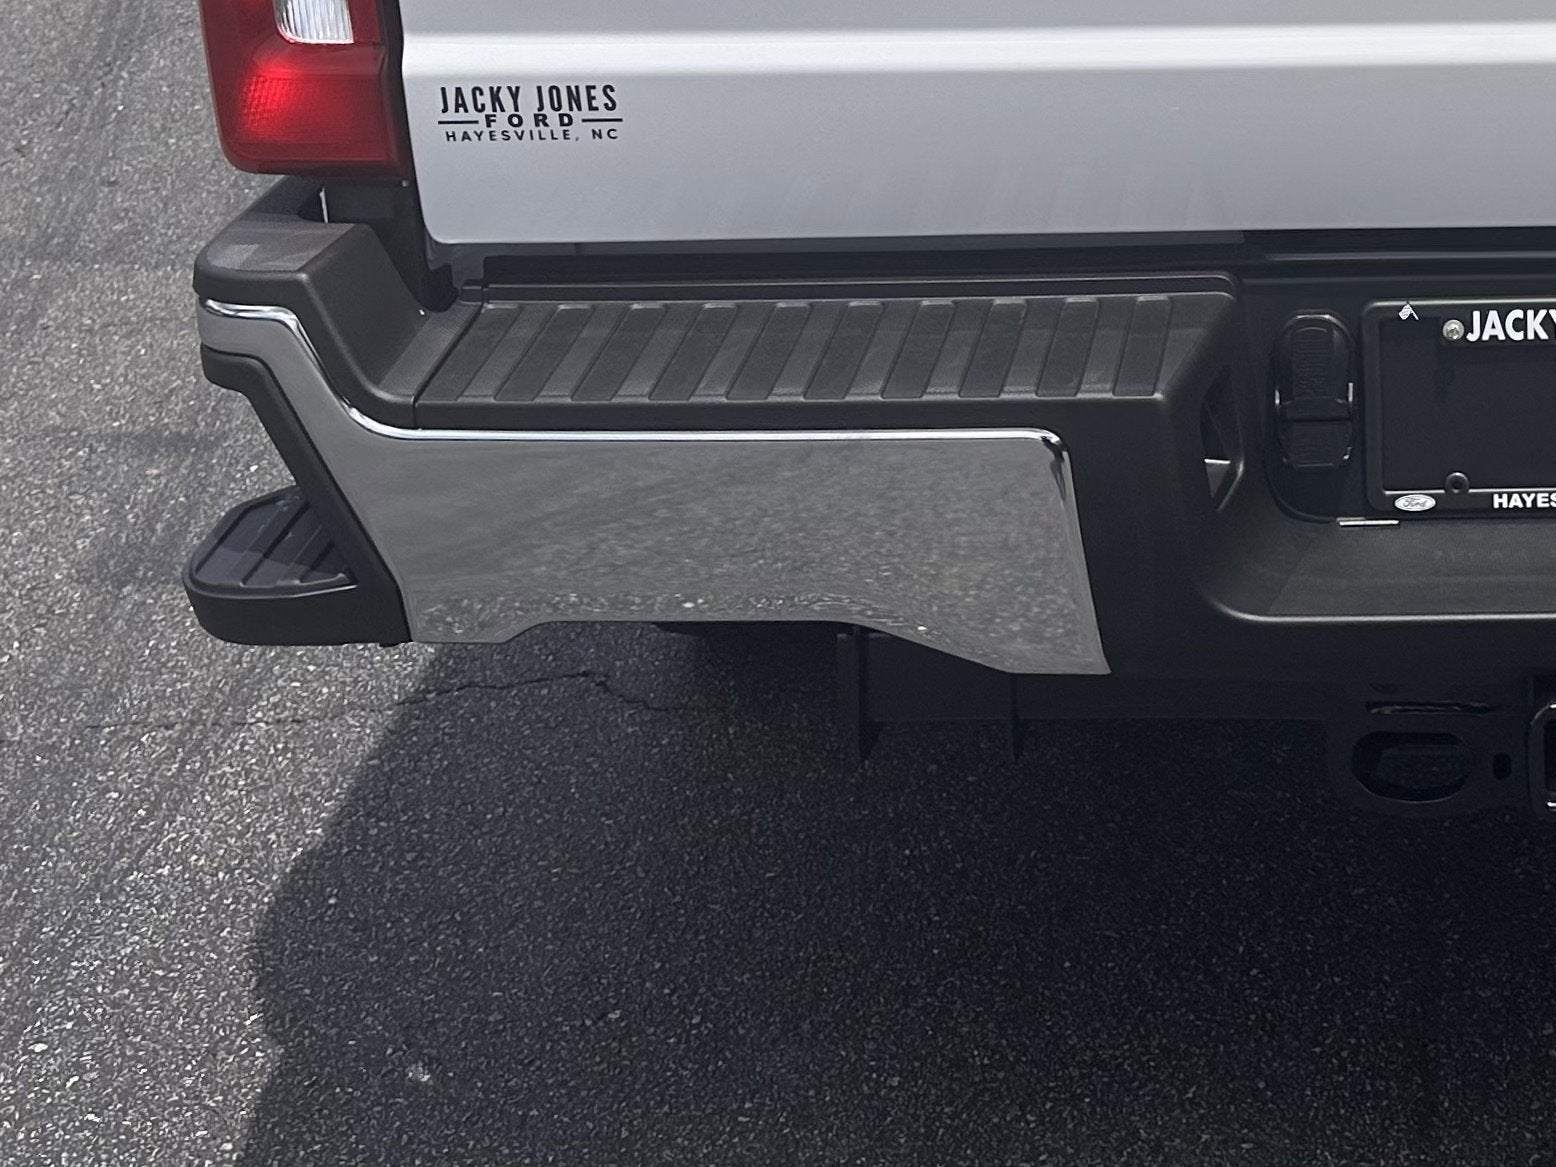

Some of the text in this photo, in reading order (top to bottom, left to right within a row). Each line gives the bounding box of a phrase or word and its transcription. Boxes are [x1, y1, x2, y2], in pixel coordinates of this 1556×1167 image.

[440, 84, 618, 114] JACKY JONES
[484, 113, 575, 128] FORD
[446, 128, 619, 142] HAYESVILLE, NC
